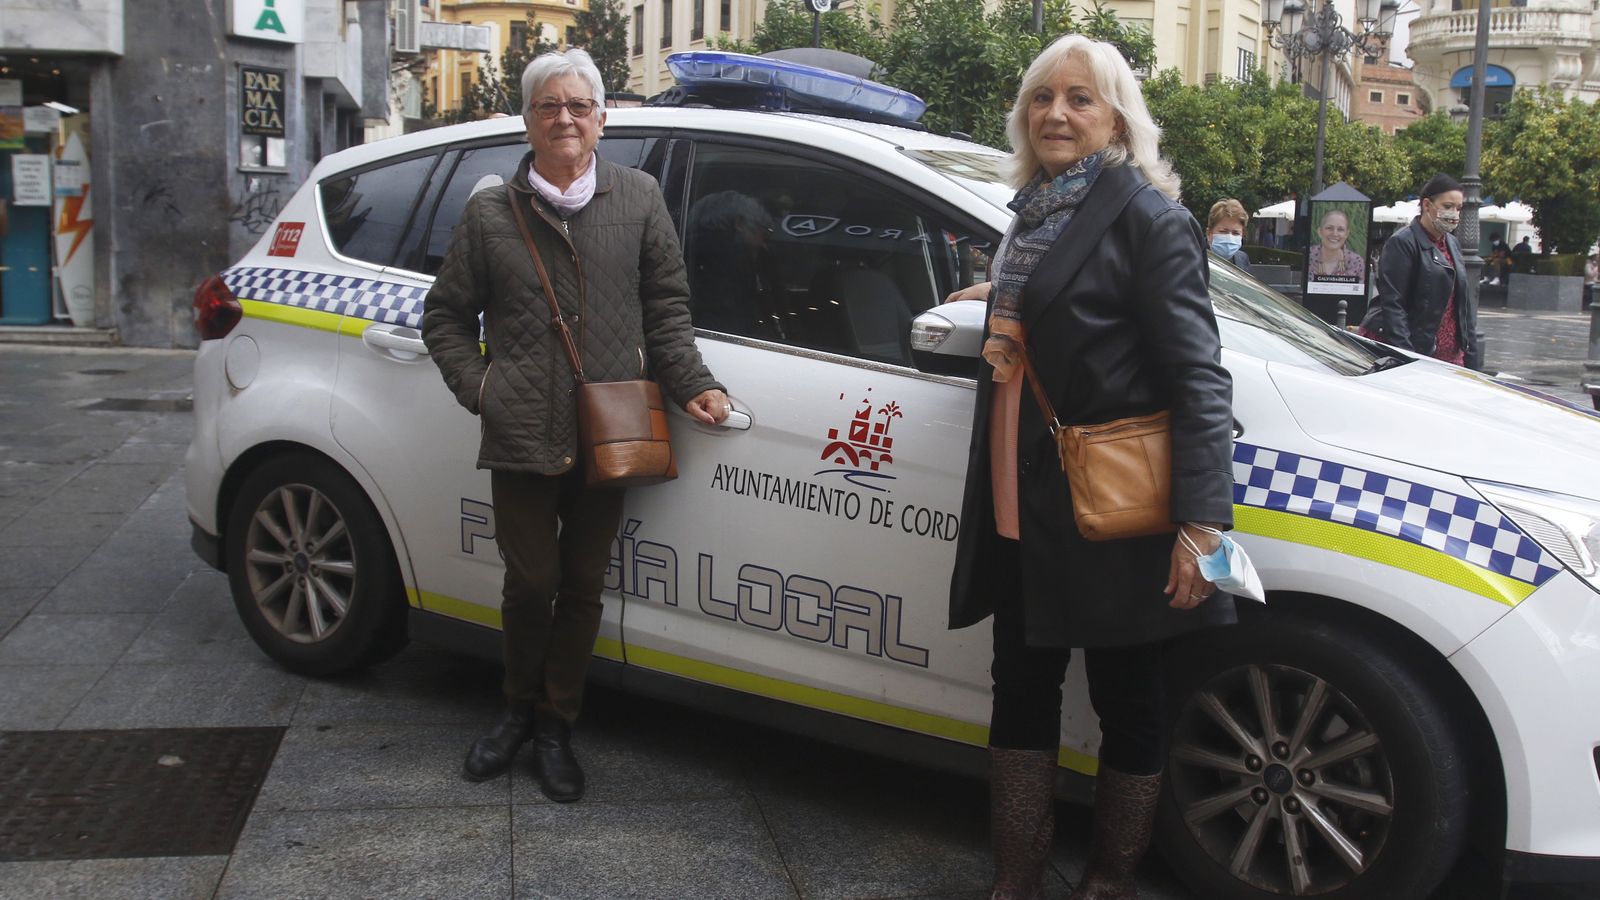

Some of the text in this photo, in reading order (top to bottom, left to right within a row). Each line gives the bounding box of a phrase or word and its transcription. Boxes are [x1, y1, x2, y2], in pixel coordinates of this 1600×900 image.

[244, 71, 281, 91] FAR
[246, 90, 278, 110] MA
[244, 109, 283, 128] CIA
[281, 228, 301, 242] 112
[711, 463, 861, 520] AYUNTAMIENTO
[869, 496, 894, 529] DE
[698, 552, 929, 669] LOCAL
